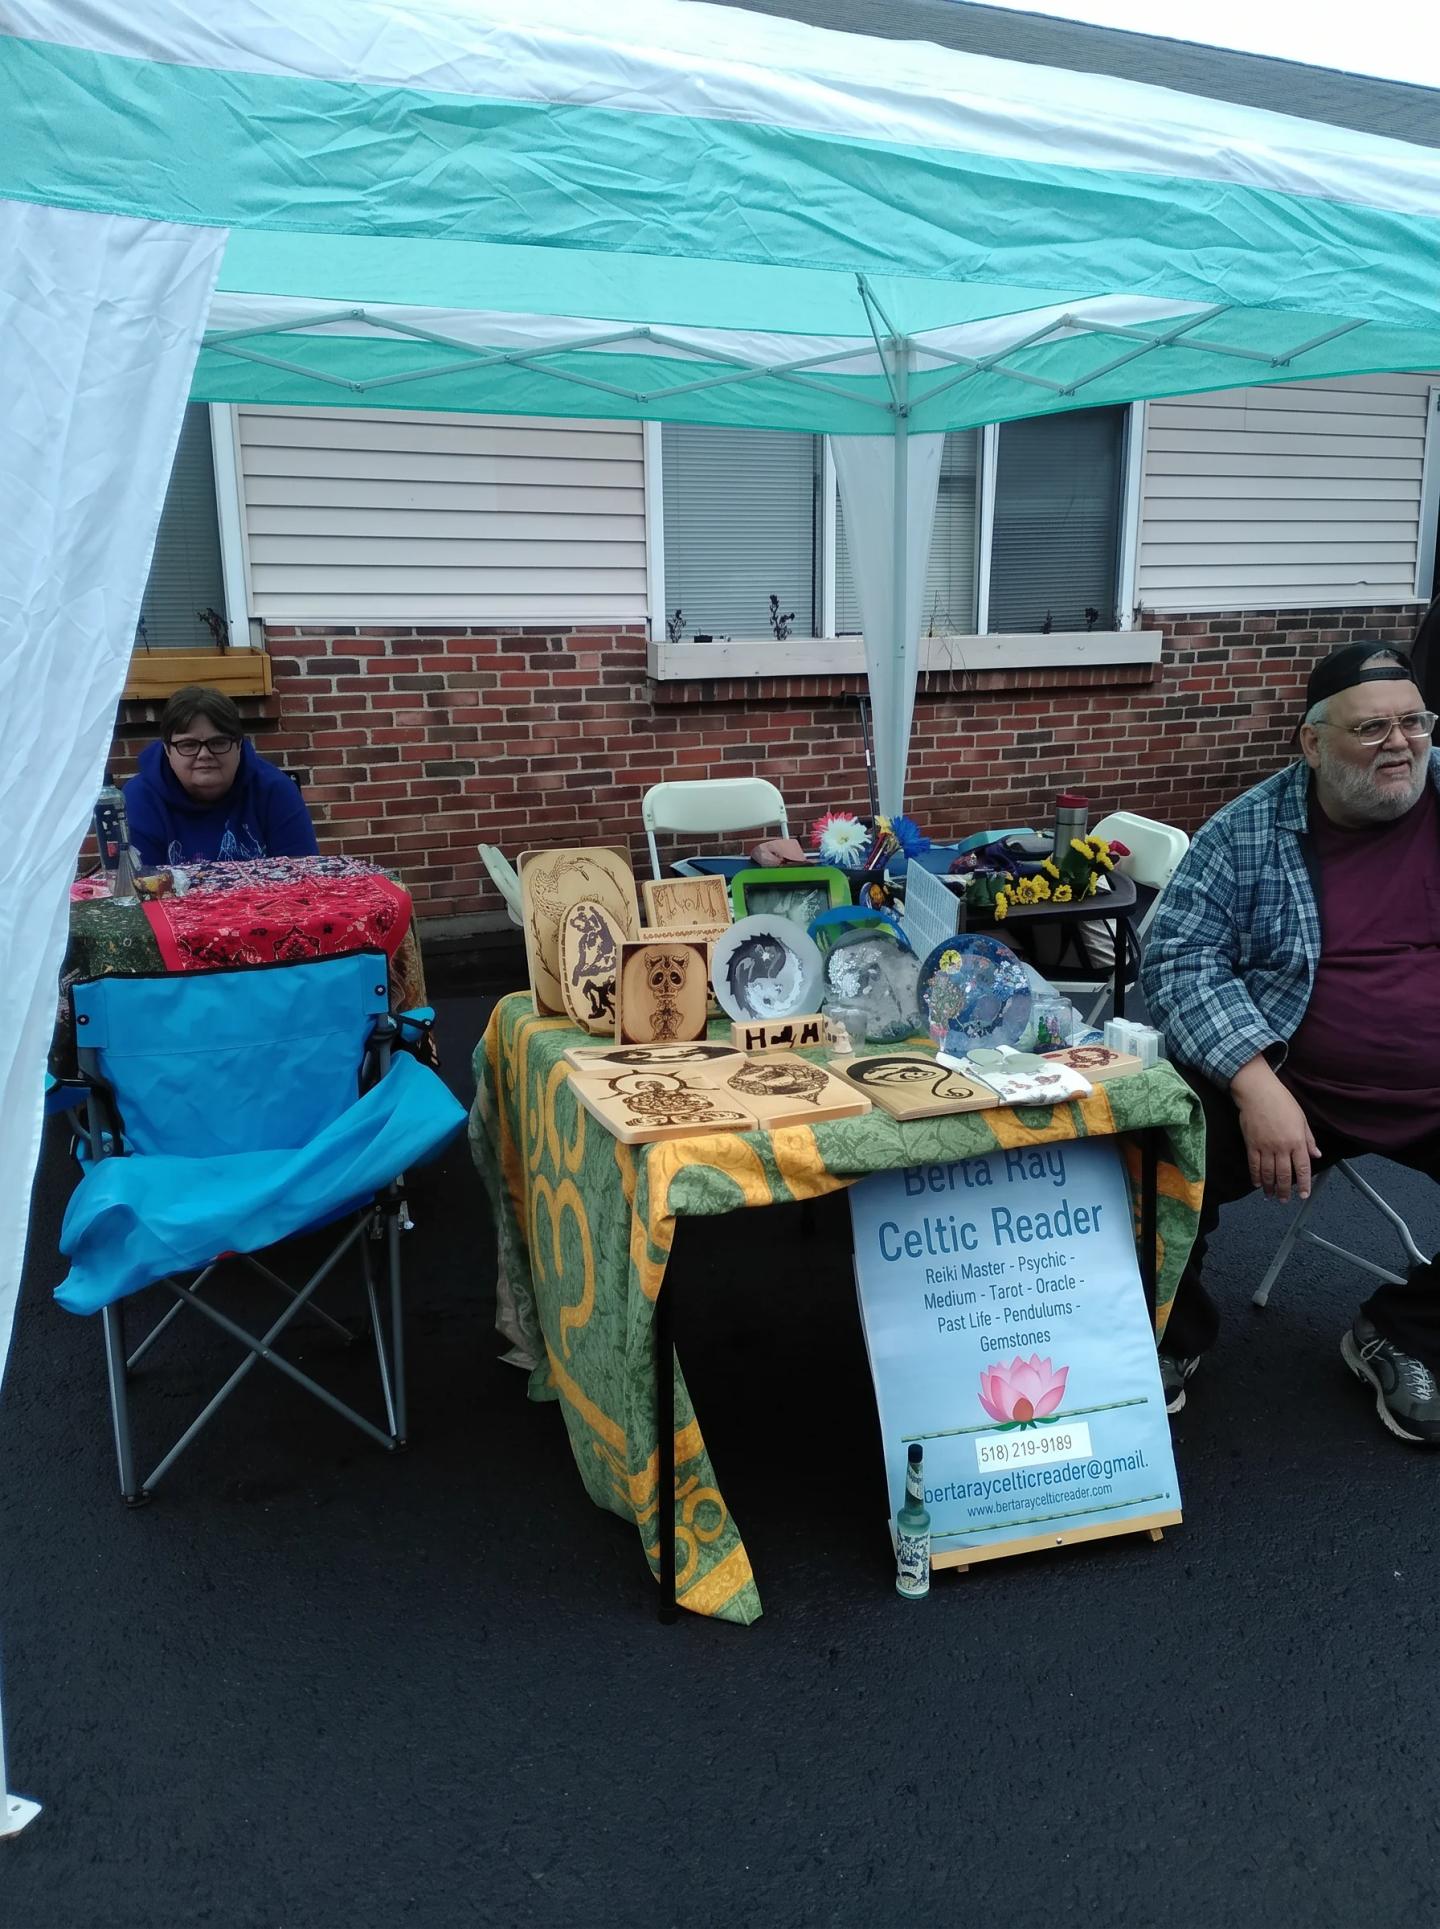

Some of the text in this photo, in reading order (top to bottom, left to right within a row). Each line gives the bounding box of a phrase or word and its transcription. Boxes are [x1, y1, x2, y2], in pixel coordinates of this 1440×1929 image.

[903, 1149, 1067, 1197] Berta Ray
[878, 1198, 1103, 1262] Celtic Reader
[925, 1264, 958, 1285] Reiki
[961, 1261, 1006, 1281] Master
[1018, 1251, 1067, 1275] Psychic
[924, 1289, 977, 1310] Medium
[989, 1283, 1025, 1301] Tarot
[1036, 1274, 1076, 1294] Oracle
[937, 1314, 967, 1334] Past
[968, 1310, 992, 1330] Life
[1003, 1301, 1073, 1324] Pendulums
[980, 1329, 1051, 1352] Gemstones
[981, 1434, 1073, 1463] 518) 219-9189
[924, 1449, 1150, 1504] bertaraycelticreader@gmail.
[967, 1482, 1113, 1518] www.bertaraycelticreader.com
